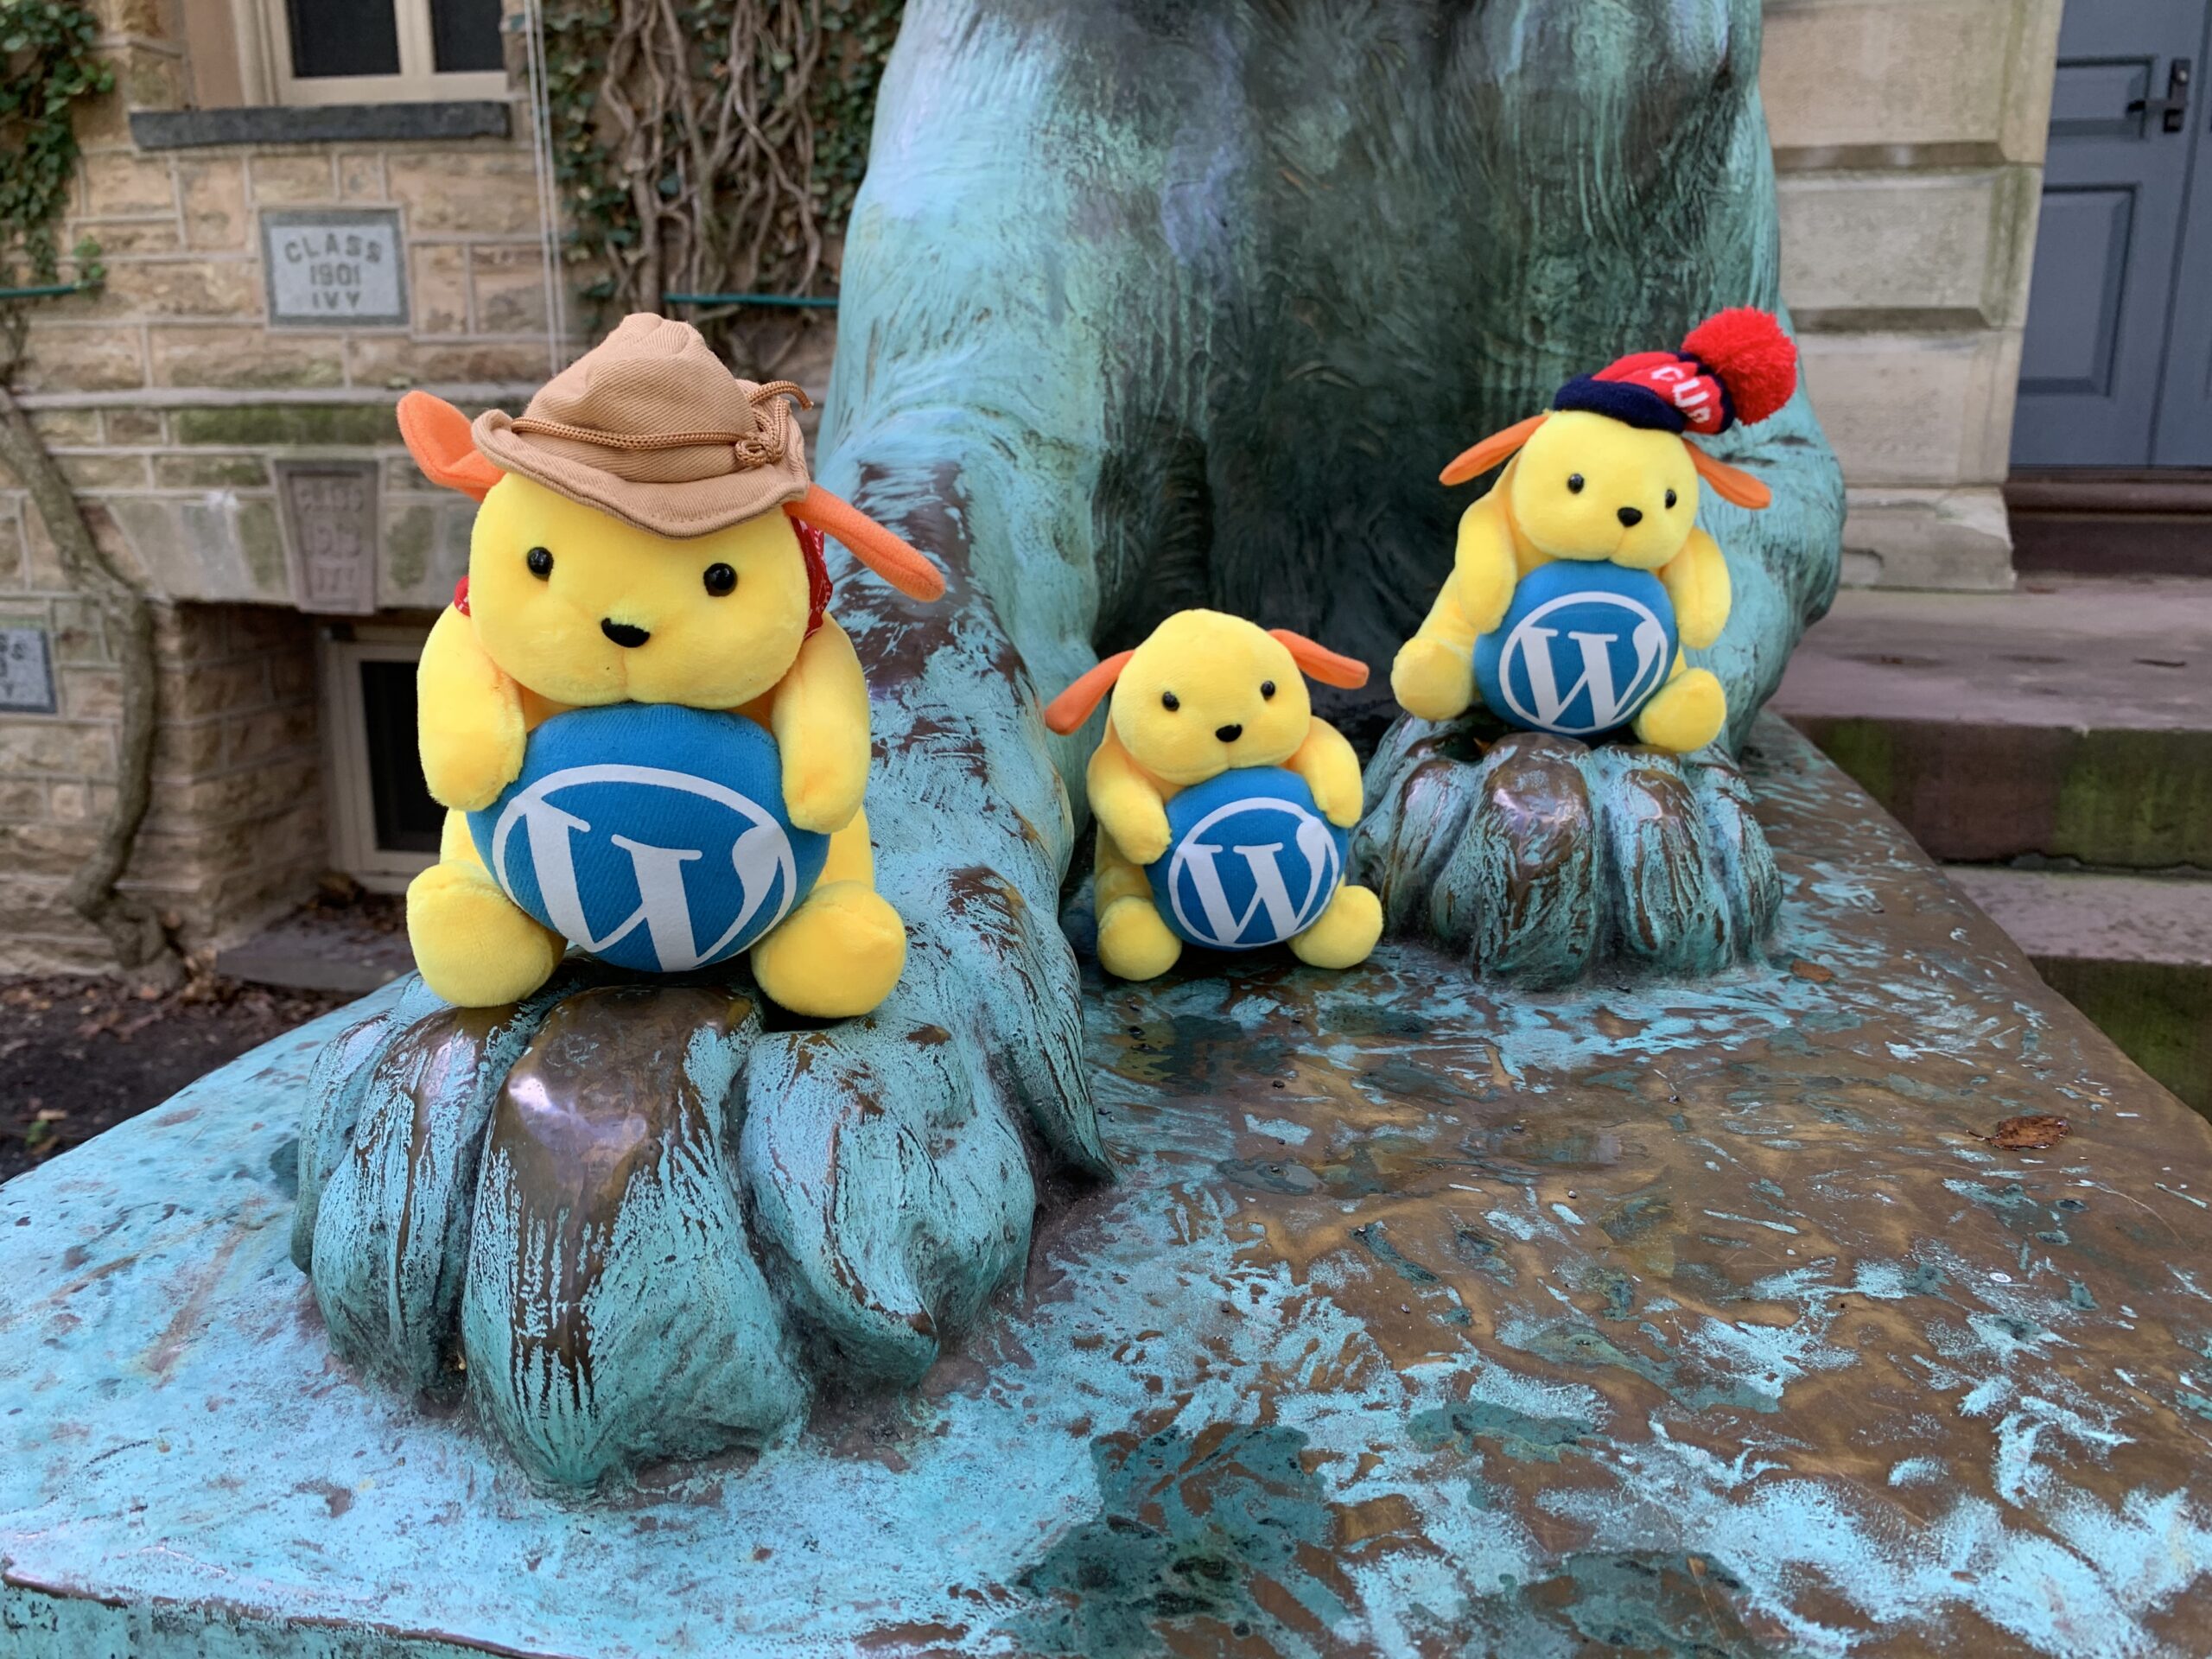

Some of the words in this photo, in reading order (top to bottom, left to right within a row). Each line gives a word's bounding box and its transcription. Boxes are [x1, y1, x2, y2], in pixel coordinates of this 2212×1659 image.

[284, 232, 383, 264] CLASS
[309, 263, 361, 287] 1901
[312, 290, 361, 310] IVY
[1513, 620, 1662, 728] W
[508, 791, 786, 972] W
[1175, 815, 1330, 945] W
